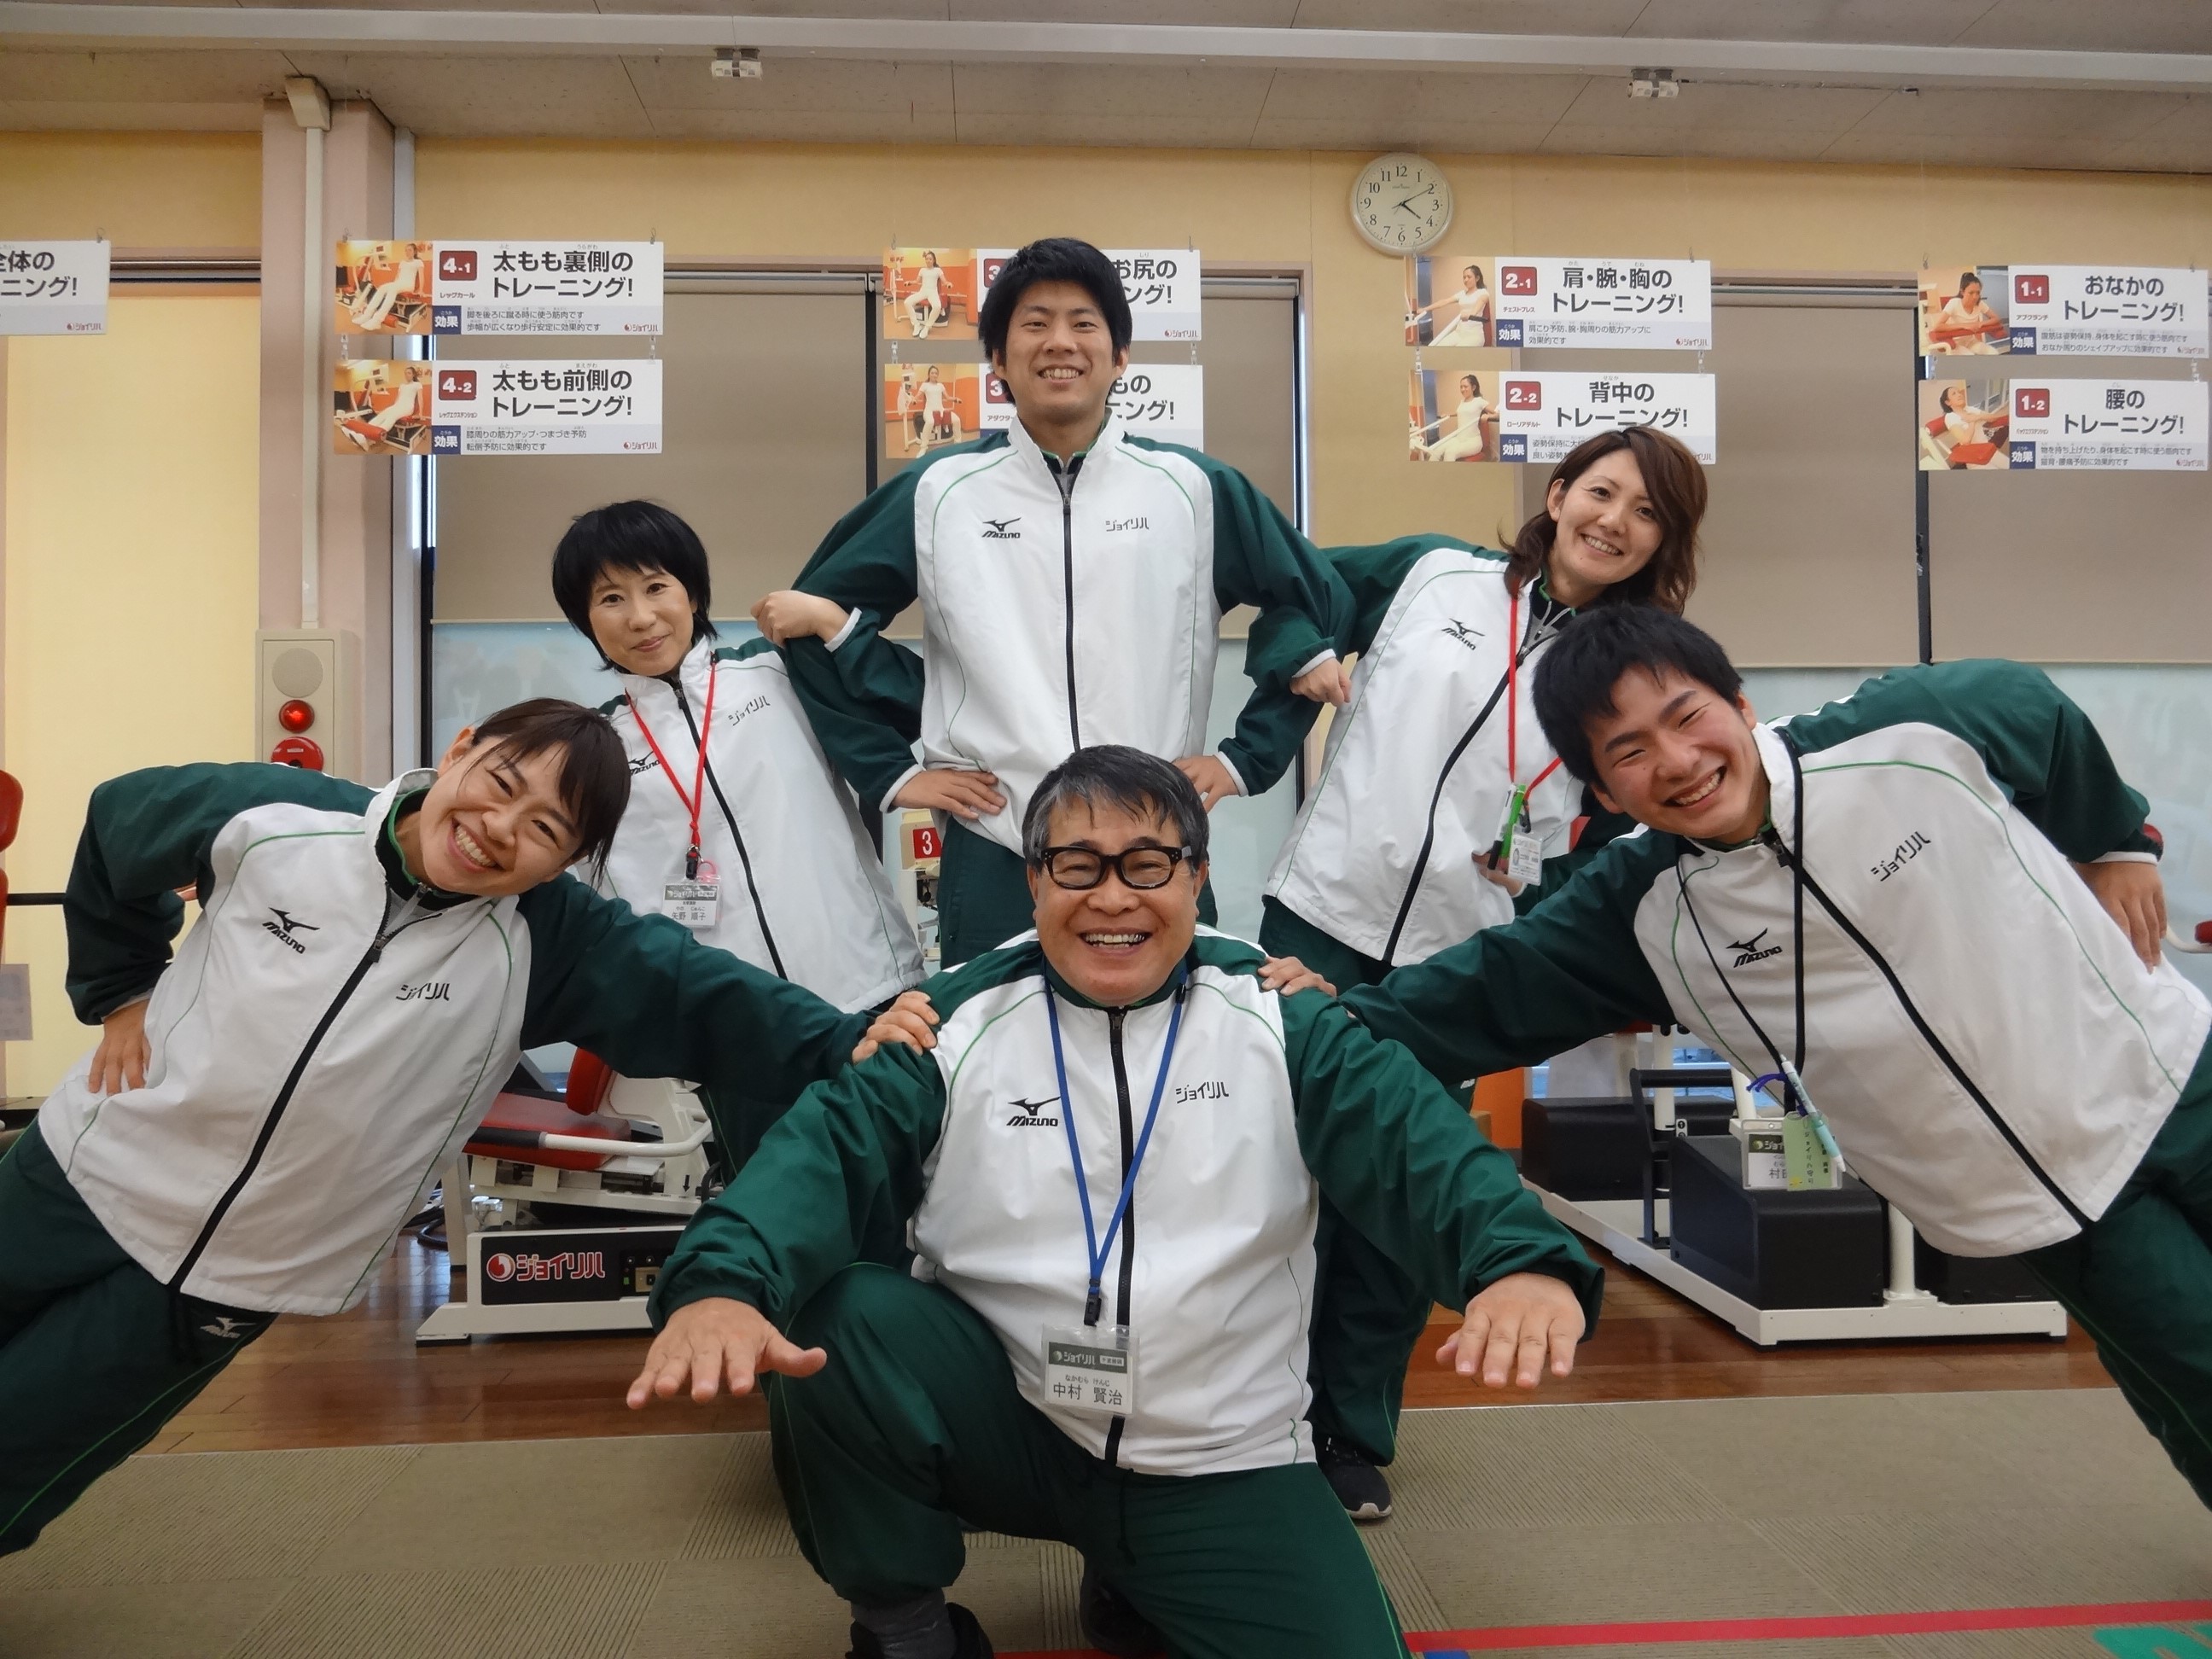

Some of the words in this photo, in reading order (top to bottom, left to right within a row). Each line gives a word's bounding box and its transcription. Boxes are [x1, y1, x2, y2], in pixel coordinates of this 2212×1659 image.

[1382, 171, 1391, 182] 11
[1396, 166, 1407, 177] 12
[1417, 171, 1421, 183] 1
[1369, 182, 1381, 194] 10
[1427, 183, 1435, 195] 2
[1364, 197, 1371, 209] 9
[1432, 199, 1440, 211] 3
[1370, 213, 1377, 226] 8
[1426, 215, 1433, 227] 4
[1383, 225, 1391, 238] 7
[1398, 230, 1406, 242] 6
[1415, 227, 1422, 239] 5
[442, 257, 472, 274] 4-1
[493, 250, 633, 273] 太もも裏側の
[1505, 272, 1532, 289] 2-1
[1563, 267, 1673, 289] 肩・腕・胸の
[1, 276, 77, 298] ニング!
[494, 276, 633, 299] トレーニング!
[2020, 281, 2043, 297] 1-1
[2085, 276, 2164, 297] おなかの
[1553, 293, 1684, 314] トレーニング!
[2064, 300, 2185, 323] トレーニング!
[434, 315, 458, 329] 効果
[467, 323, 602, 332] 歩幅が広くなり歩行安定に効果的です
[632, 323, 658, 332] ジョイリハ
[1173, 329, 1198, 338] ジョイリハ
[1499, 329, 1522, 341] 効果
[1528, 336, 1567, 345] 効果的です
[1683, 338, 1709, 346] ジョイリハ
[2012, 336, 2034, 348] 効果
[442, 376, 472, 393] 4-2
[492, 369, 632, 392] 太もも前側の
[1509, 387, 1537, 404] 2-2
[1589, 381, 1655, 404] 背中の
[2105, 388, 2145, 410] 腰の
[493, 395, 632, 417] トレーニング!
[2021, 395, 2046, 411] 1-2
[1557, 407, 1688, 428] トレーニング!
[2064, 415, 2185, 435] トレーニング!
[434, 435, 458, 448] 効果
[632, 442, 657, 451] ジョイリハ
[1502, 444, 1525, 456] 効果
[2011, 451, 2034, 463] 効果
[1105, 517, 1150, 532] ジョイリハ
[981, 530, 1021, 538] MIZUNO
[1441, 627, 1476, 651] MIZUNO
[727, 696, 771, 726] ジョイリハ
[922, 830, 933, 856] 3
[1871, 831, 1931, 882] ジョイリハ
[262, 921, 306, 954] MIZUNO
[1733, 946, 1783, 968] MIZUNO
[395, 982, 451, 1002] ジョイリハ
[1175, 1081, 1230, 1103] ジョイリハ
[1005, 1115, 1059, 1127] MIZUNO
[515, 1251, 606, 1282] ジョイリハ
[1063, 1351, 1096, 1365] ジョイリハ
[1065, 1374, 1090, 1384] なかむら
[1053, 1382, 1082, 1400] 中村
[1093, 1387, 1123, 1406] 賢治
